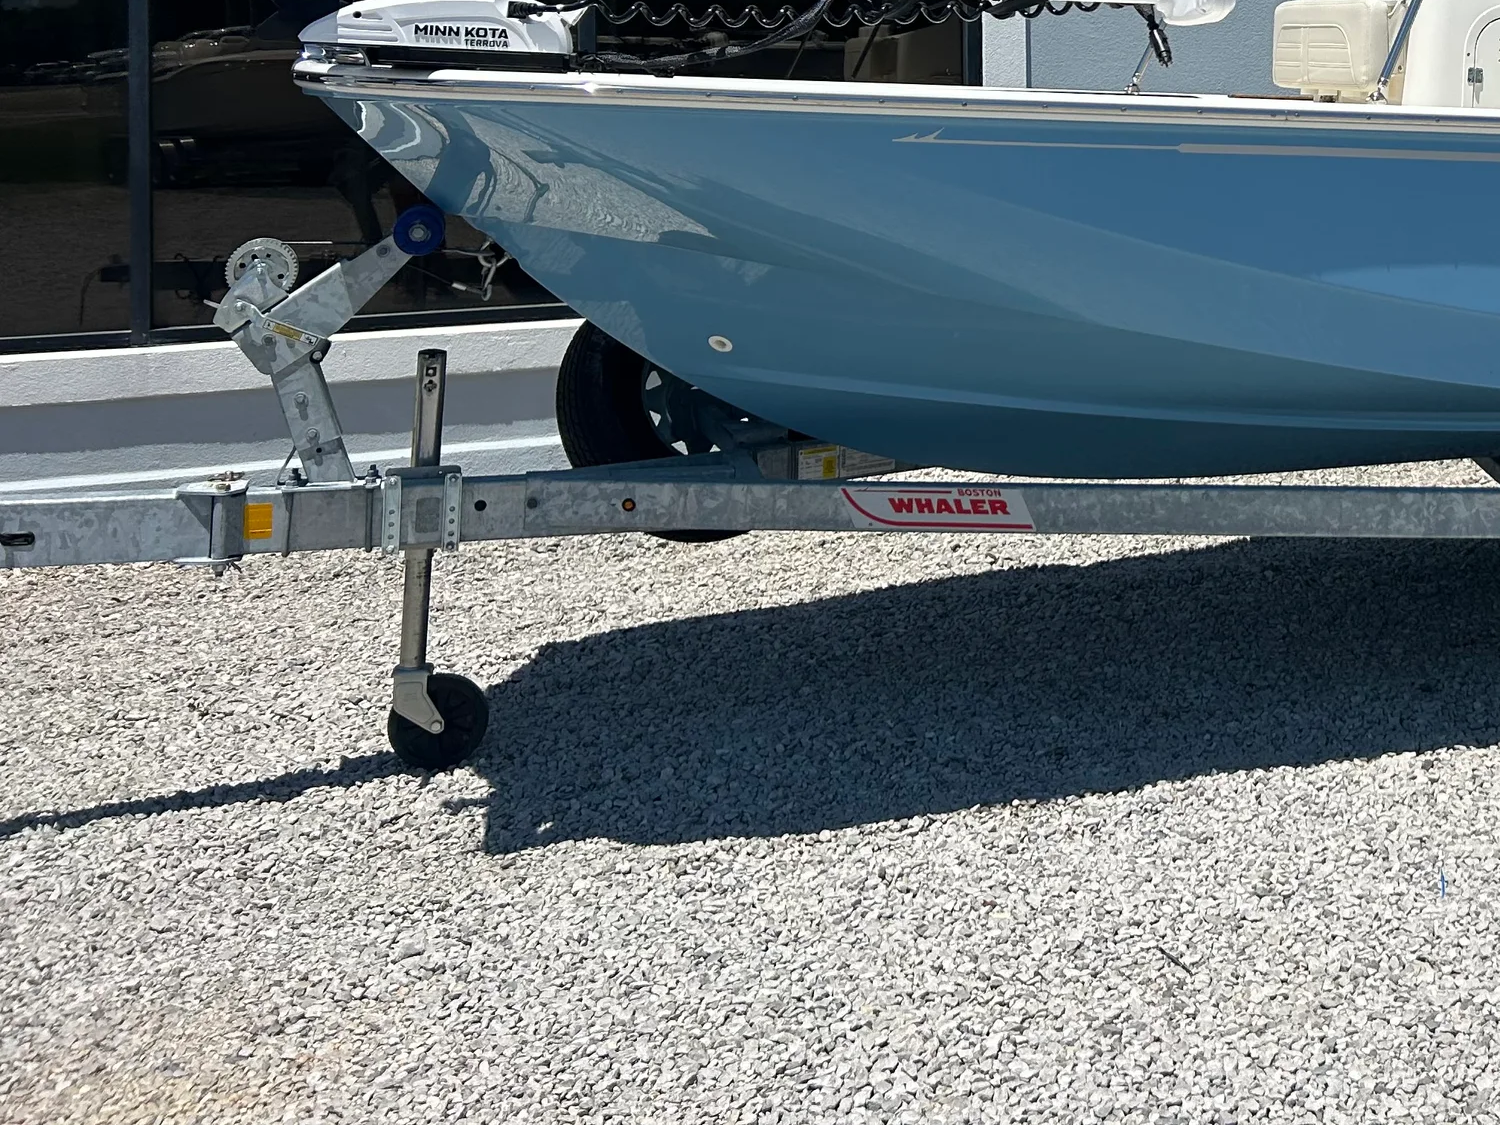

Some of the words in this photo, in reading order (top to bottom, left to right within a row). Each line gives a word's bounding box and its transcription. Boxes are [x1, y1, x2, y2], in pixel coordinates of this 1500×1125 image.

[414, 24, 461, 37] MINN
[464, 26, 509, 40] KOTA
[464, 38, 509, 49] TERROVA
[957, 488, 1002, 497] BOSTON
[888, 498, 1011, 515] WHALER
